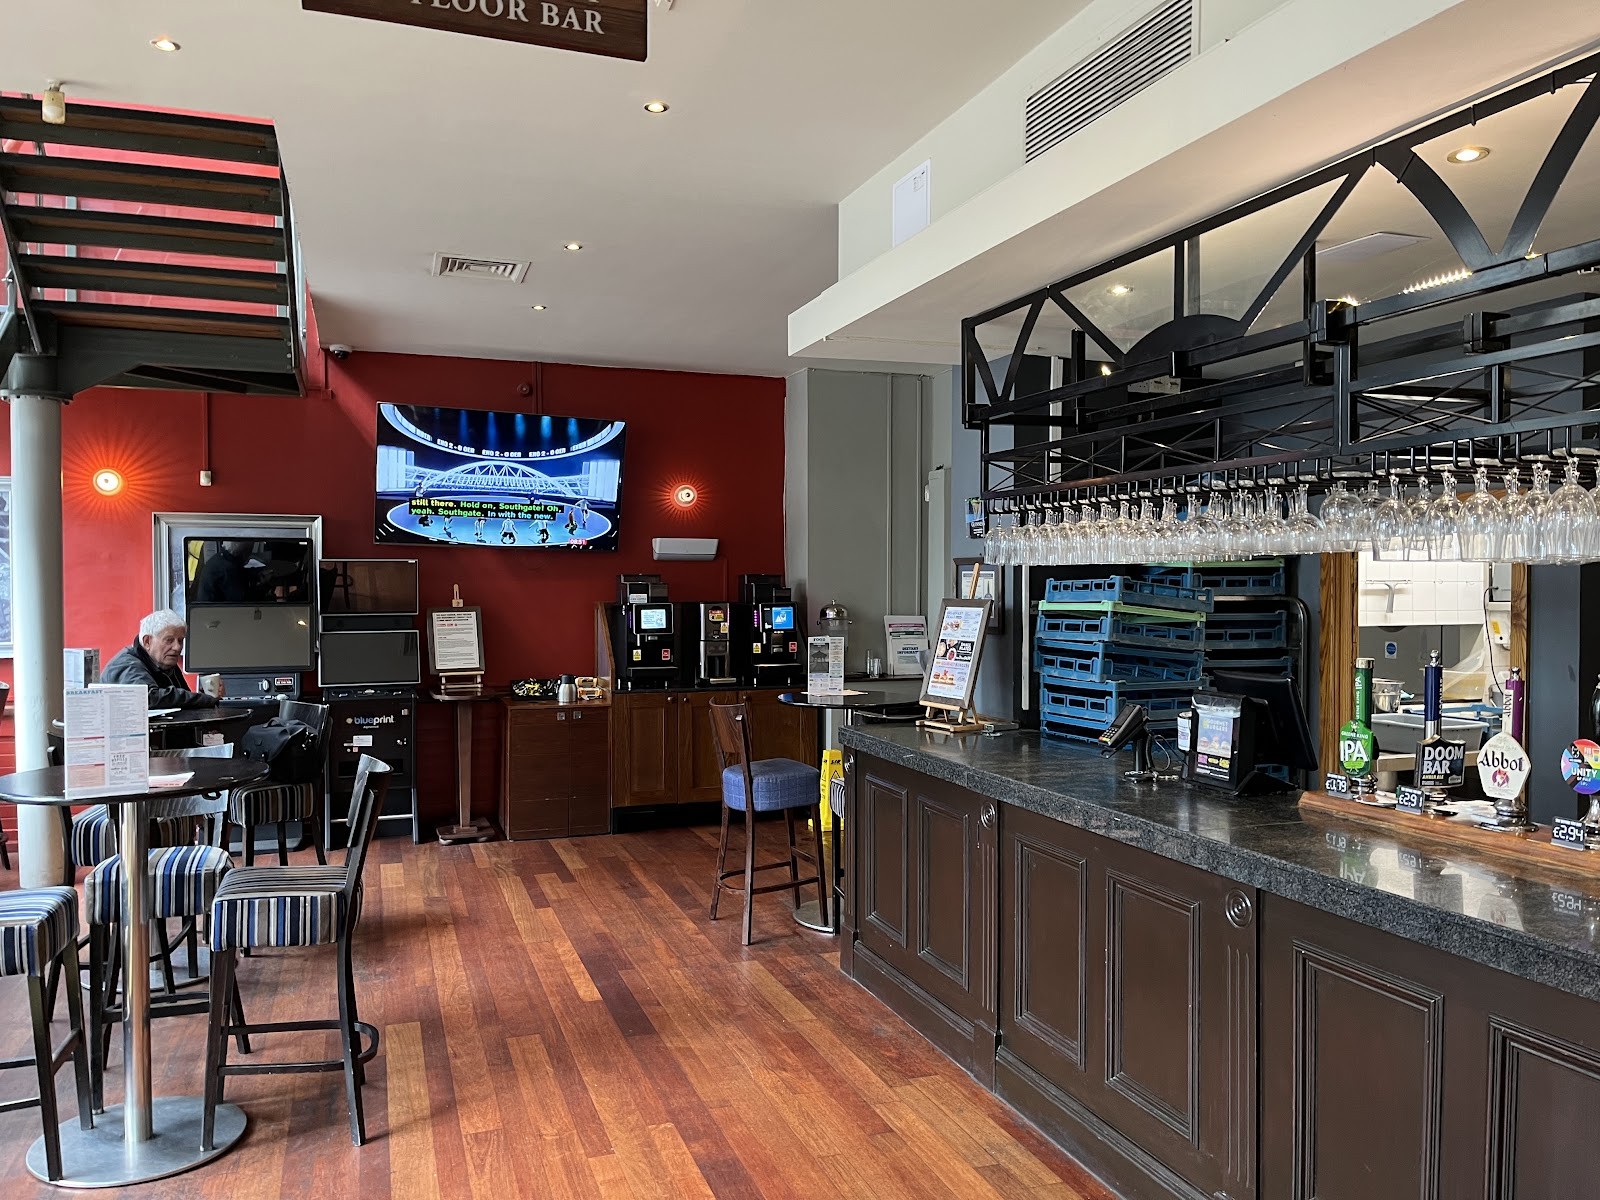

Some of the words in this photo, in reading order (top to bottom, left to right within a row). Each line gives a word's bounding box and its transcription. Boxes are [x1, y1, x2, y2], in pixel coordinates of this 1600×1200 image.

[411, 0, 529, 22] OOR
[540, 2, 605, 34] BAR
[411, 508, 435, 516] yeah.
[438, 508, 485, 517] Southgate.
[460, 501, 480, 509] Hold
[499, 503, 545, 513] Southgate!
[547, 505, 562, 513] Oh,
[354, 715, 394, 725] blueprint
[1340, 740, 1368, 762] IPA
[1424, 745, 1464, 761] DOOM
[1423, 760, 1450, 774] BAR
[1479, 749, 1525, 772] Abbot
[1571, 767, 1597, 778] UNITY
[1399, 793, 1422, 808] £2.91
[1552, 825, 1584, 841] £2.94
